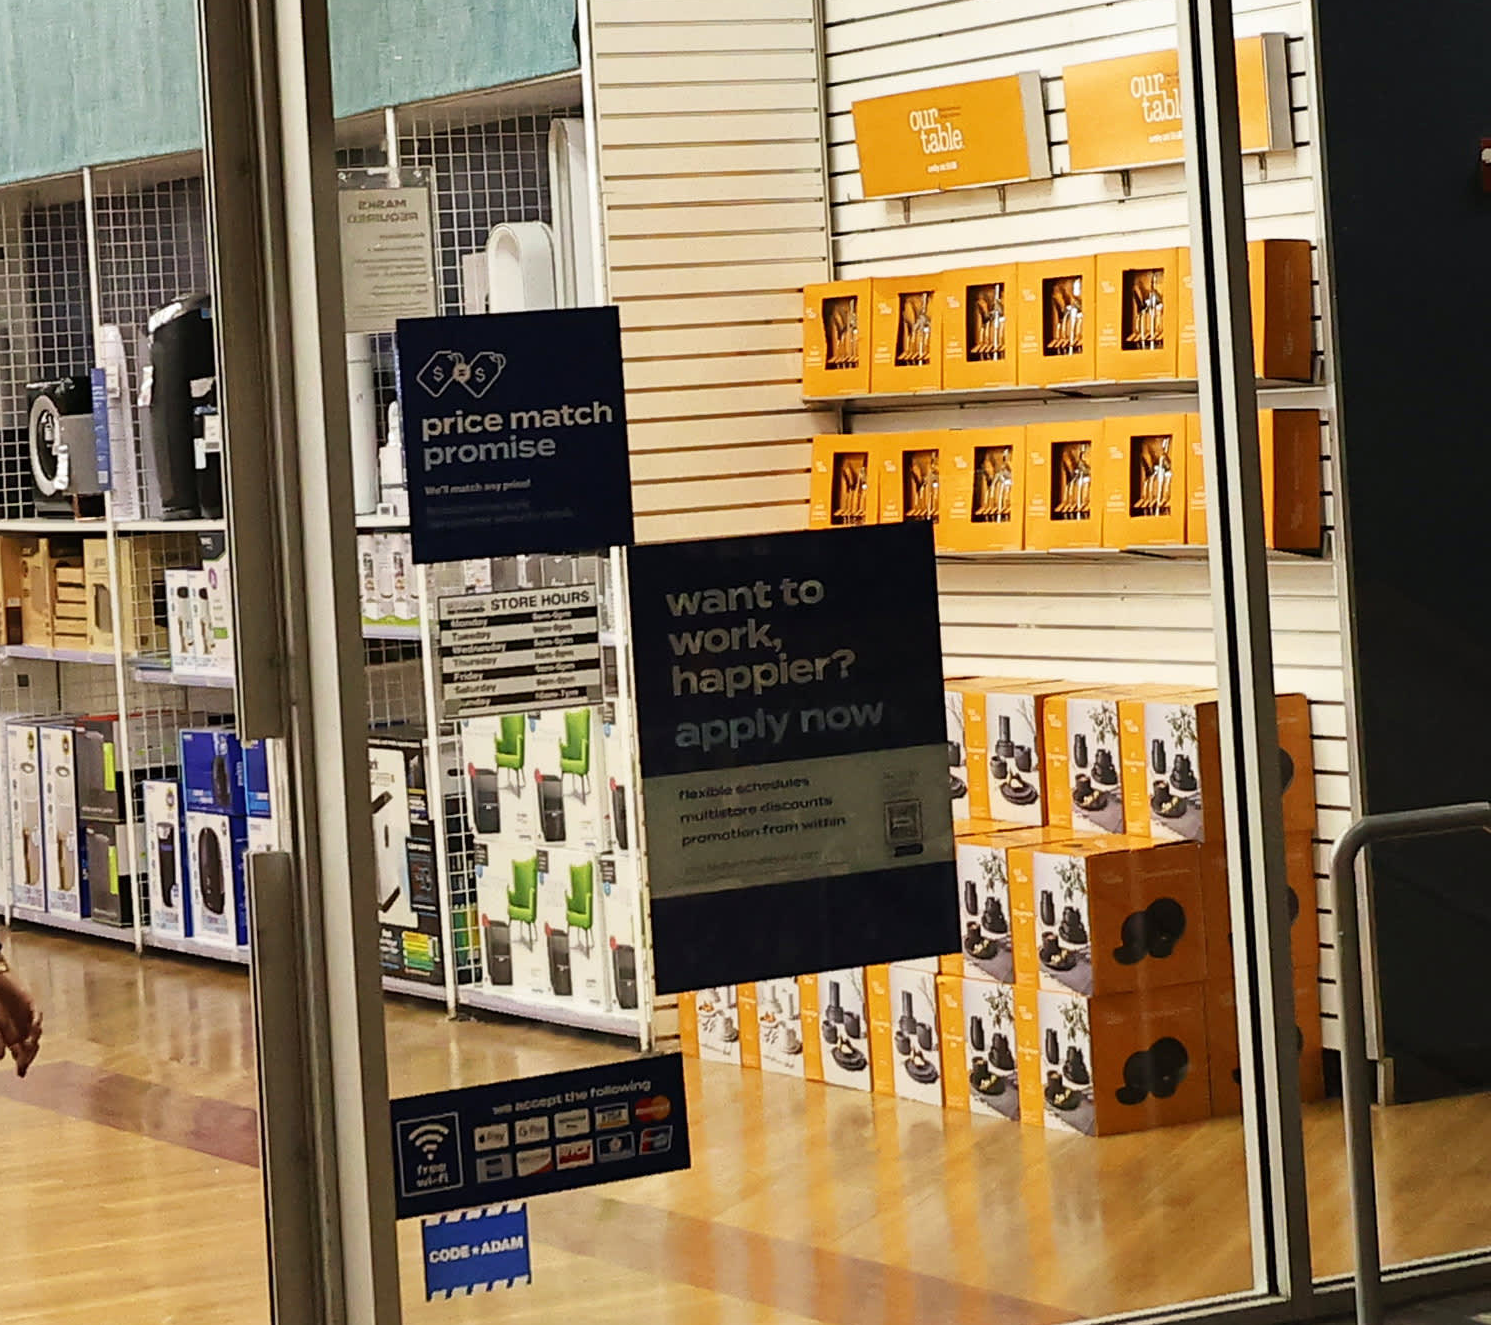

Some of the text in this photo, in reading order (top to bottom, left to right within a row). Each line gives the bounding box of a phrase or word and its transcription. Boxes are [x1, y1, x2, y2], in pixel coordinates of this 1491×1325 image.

[1131, 72, 1165, 98] our
[909, 107, 939, 131] our
[1142, 88, 1183, 124] tabl
[920, 122, 964, 155] table
[421, 400, 613, 442] price match
[423, 434, 557, 472] promise
[491, 595, 537, 611] STORE
[541, 590, 590, 606] HOURS
[665, 578, 825, 616] want to
[451, 631, 491, 641] Tuesday
[668, 618, 783, 656] work,
[452, 656, 498, 668] Thursday
[671, 648, 857, 698] happier?
[454, 683, 498, 695] Saturday
[674, 701, 884, 752] apply now
[678, 776, 810, 801] flexible schedules
[680, 794, 833, 824] multistore discounts
[682, 814, 847, 847] promotion from within
[515, 1095, 563, 1113] accept
[564, 1090, 589, 1103] the
[590, 1079, 652, 1098] following
[429, 1235, 524, 1264] CODE ADAM
